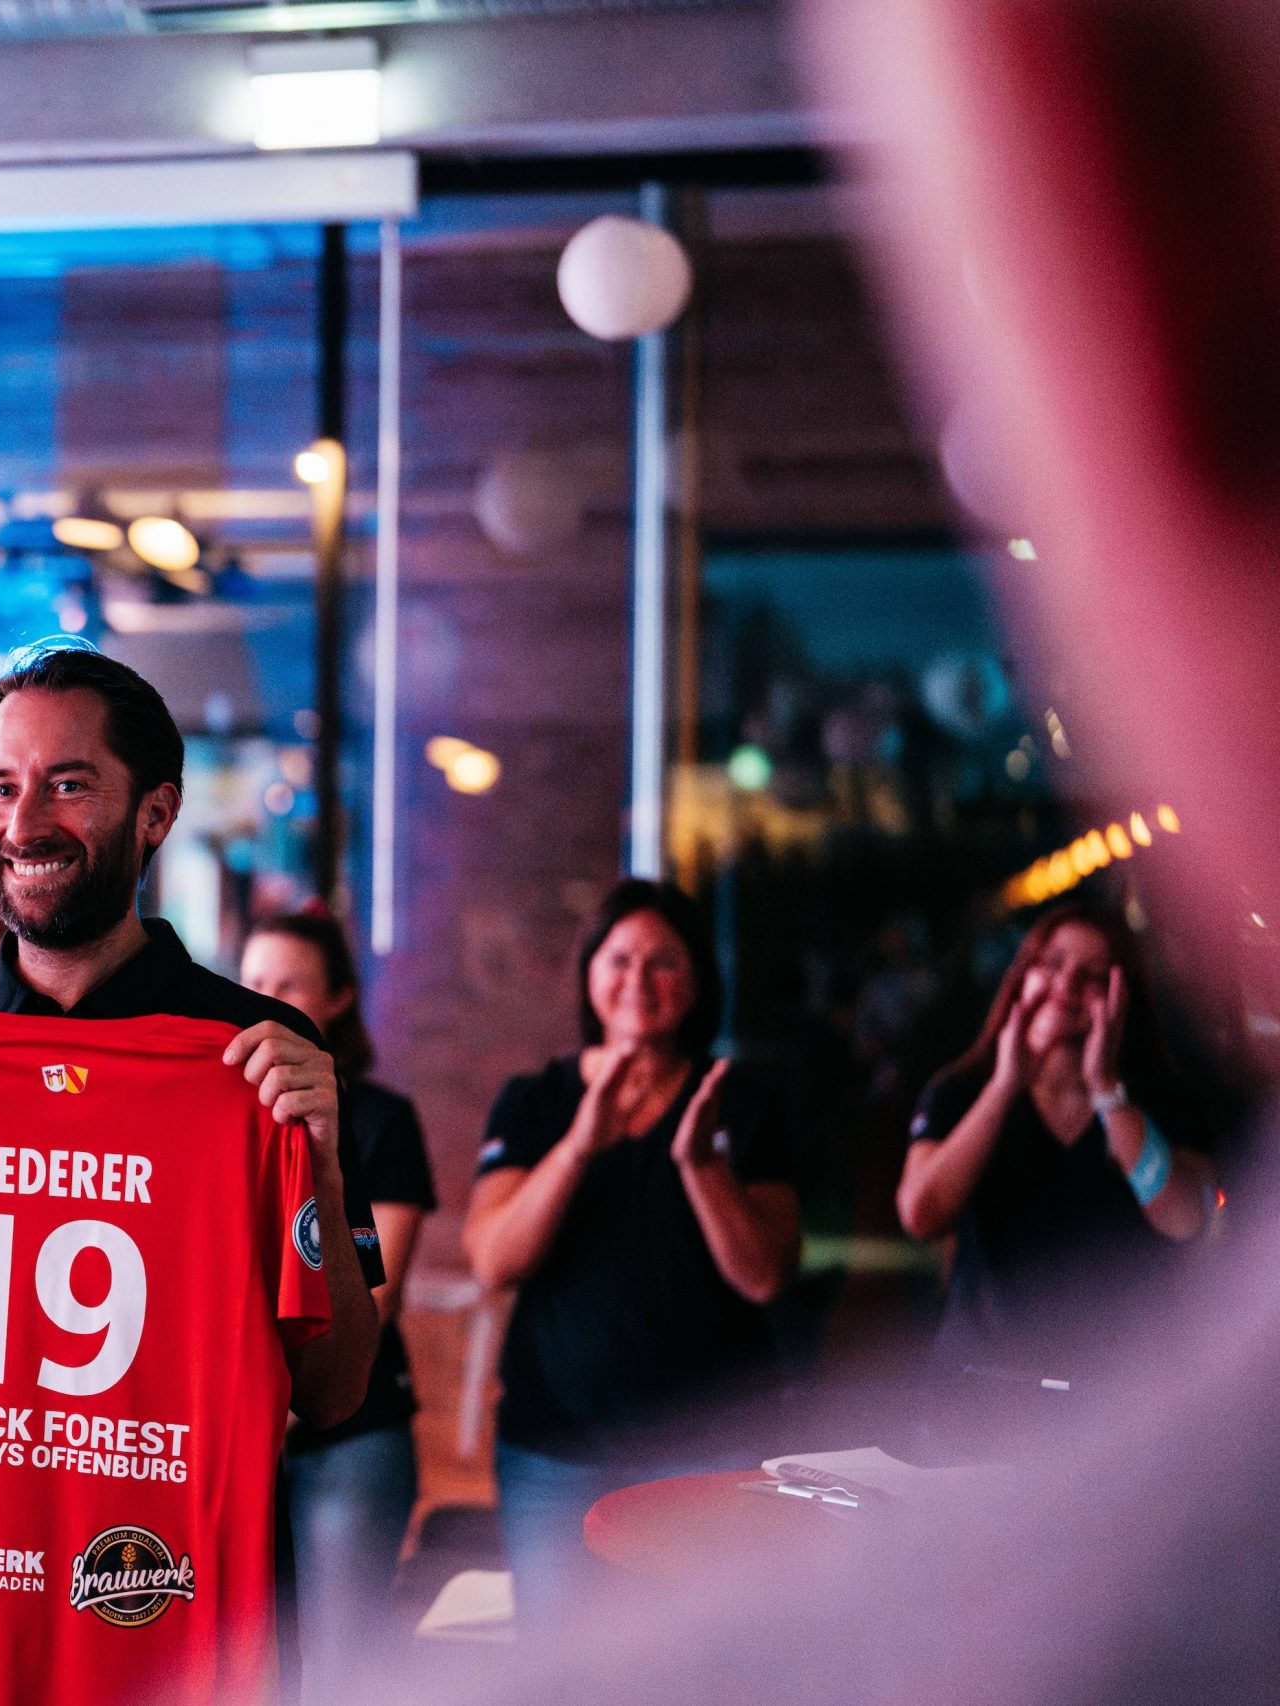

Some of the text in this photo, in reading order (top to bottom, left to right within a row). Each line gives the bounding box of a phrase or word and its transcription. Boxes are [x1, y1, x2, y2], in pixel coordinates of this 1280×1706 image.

[44, 1411, 190, 1457] FOREST
[31, 1446, 187, 1483] OFFENBURG
[92, 1532, 127, 1556] PREMIUM
[70, 1555, 195, 1606] Brauwerk
[101, 1606, 124, 1621] BADEN
